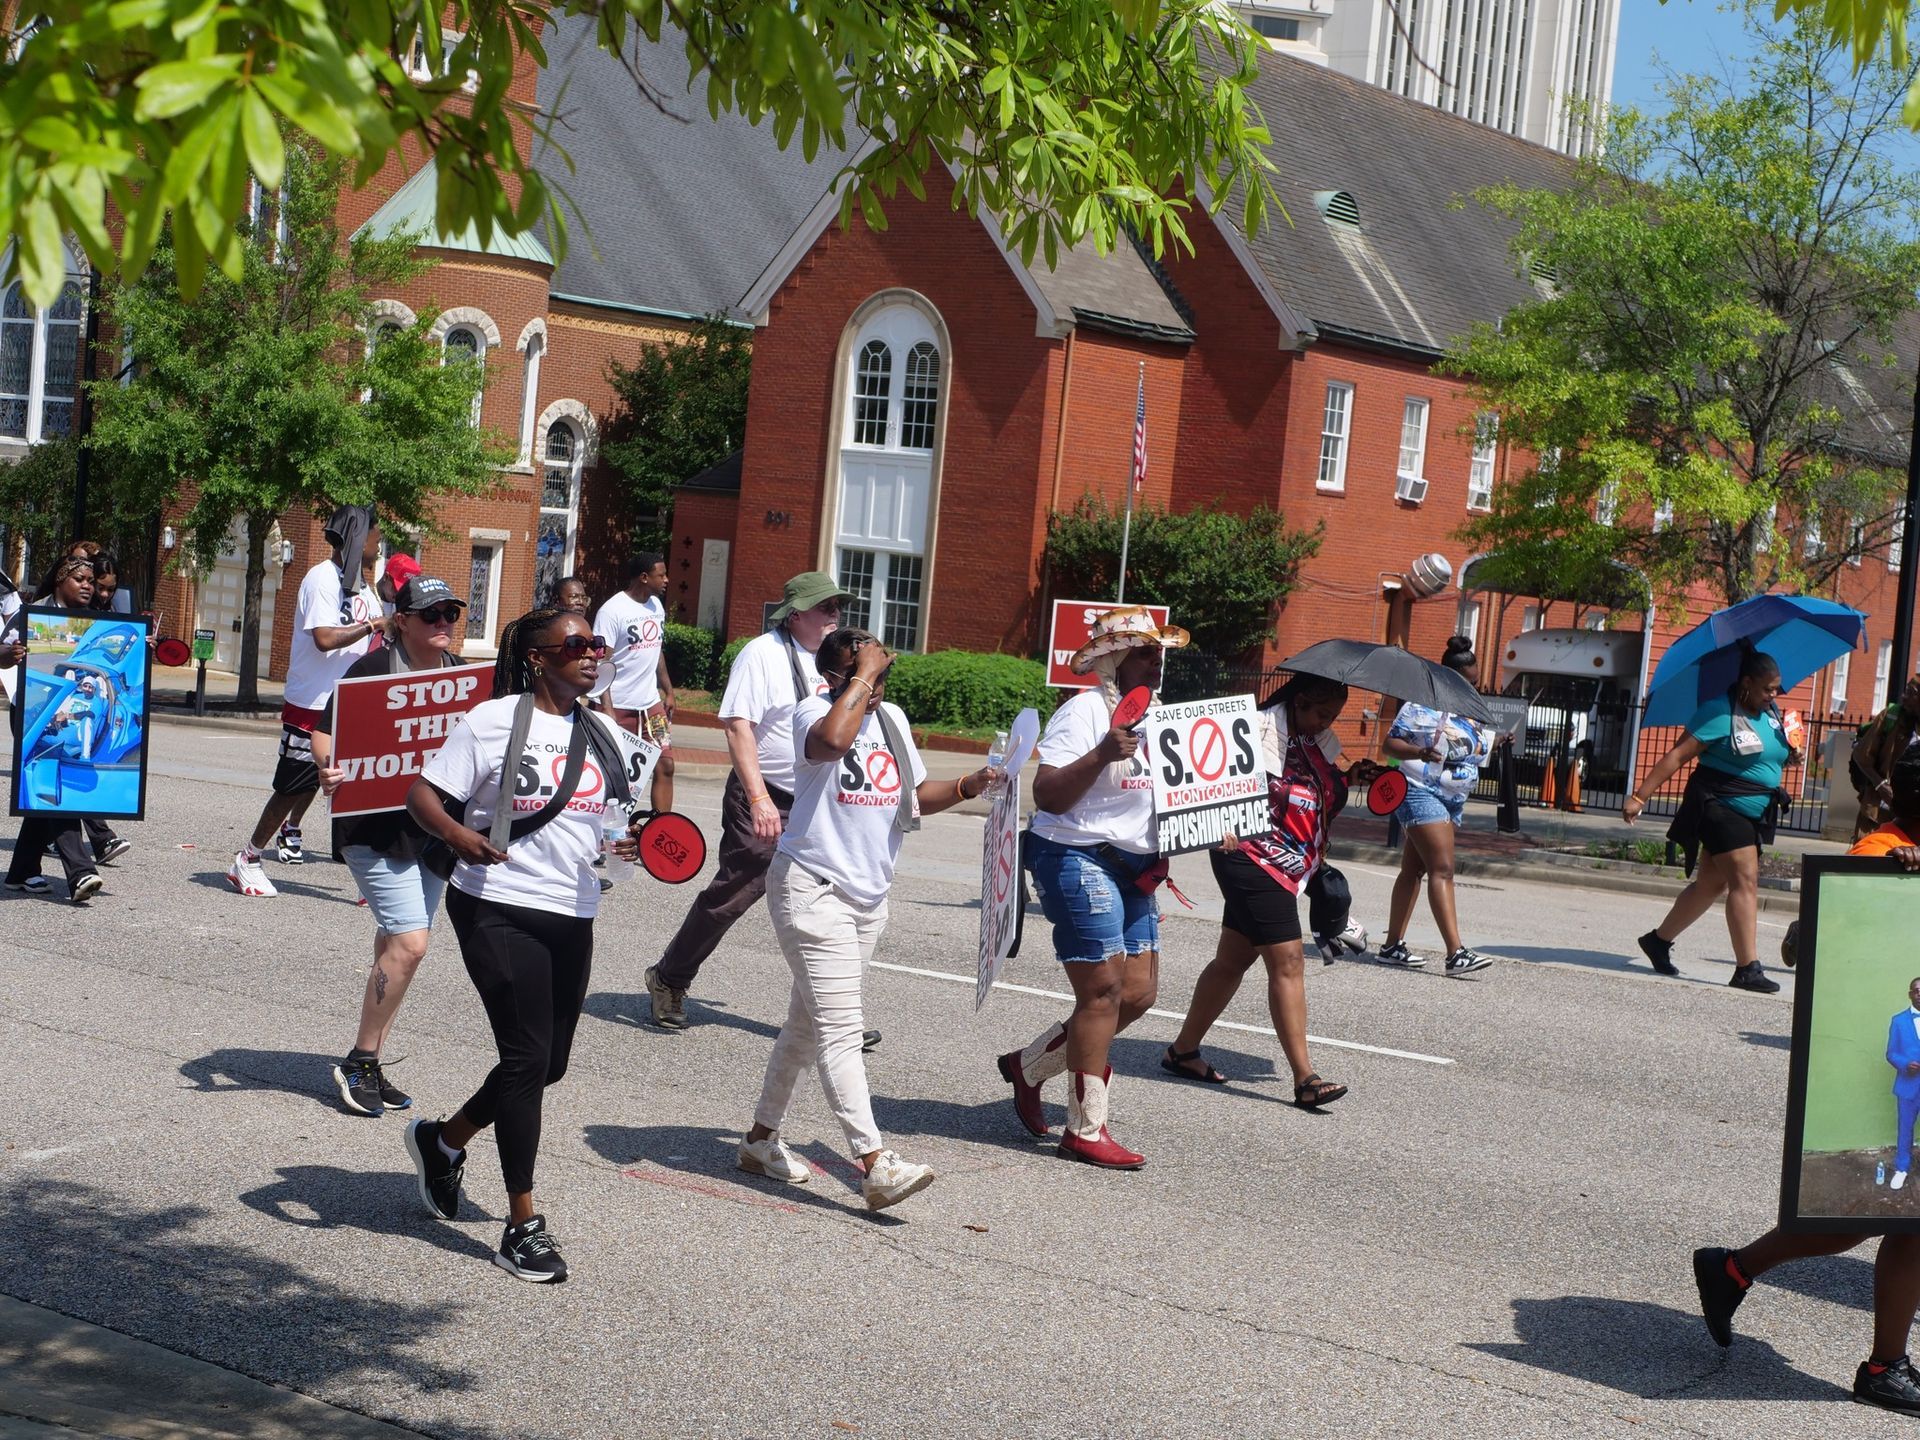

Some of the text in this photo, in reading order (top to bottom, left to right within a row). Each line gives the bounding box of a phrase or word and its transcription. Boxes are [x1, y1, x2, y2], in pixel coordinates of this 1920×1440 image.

[386, 676, 478, 710] STOP
[1155, 708, 1182, 723] SAVE
[1184, 705, 1206, 719] OUR
[1207, 700, 1247, 715] STREETS
[1487, 702, 1526, 714] BUILDING
[843, 793, 901, 806] MONTGO
[1171, 779, 1257, 806] MONTGOMERY
[1158, 799, 1272, 853] #PUSHINGPEACE
